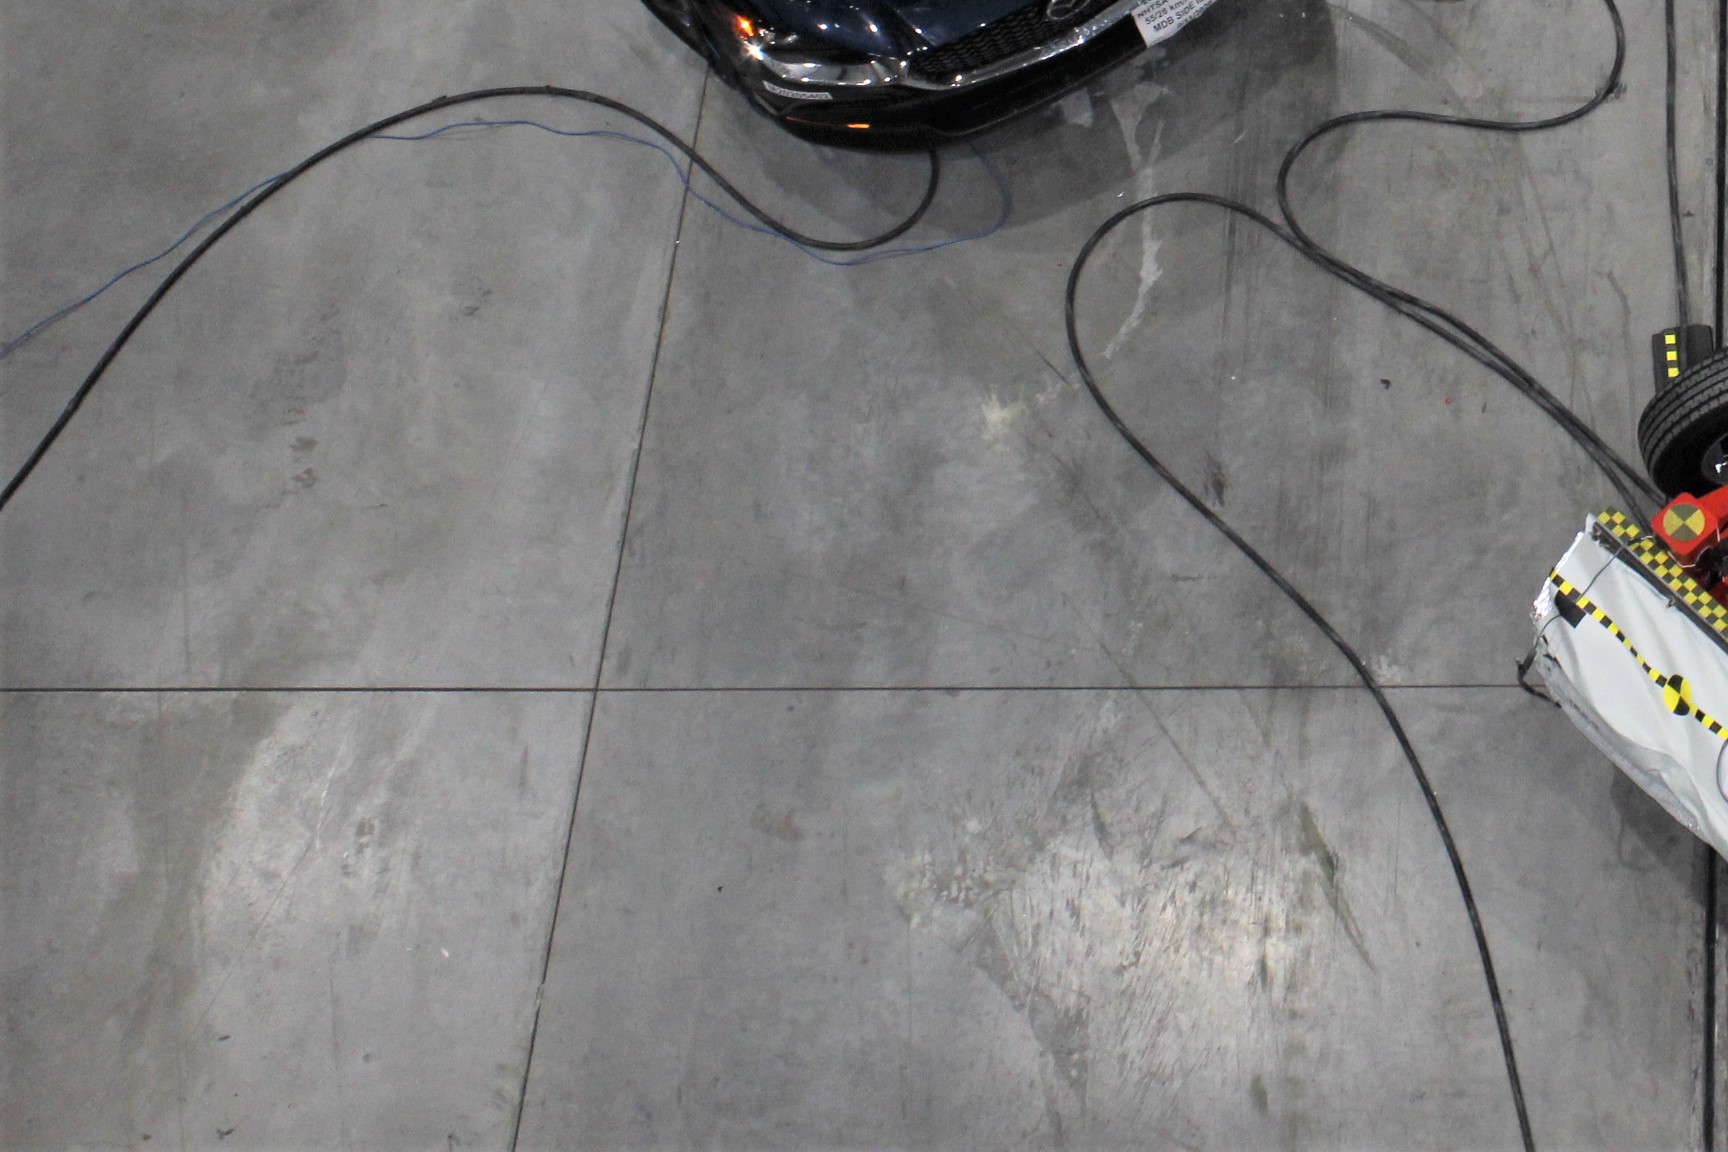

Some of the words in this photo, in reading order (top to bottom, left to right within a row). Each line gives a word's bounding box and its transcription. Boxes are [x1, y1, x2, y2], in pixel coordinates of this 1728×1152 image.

[1145, 8, 1168, 24] 55/28
[1153, 17, 1174, 32] MDB
[1176, 1, 1196, 19] SIDE
